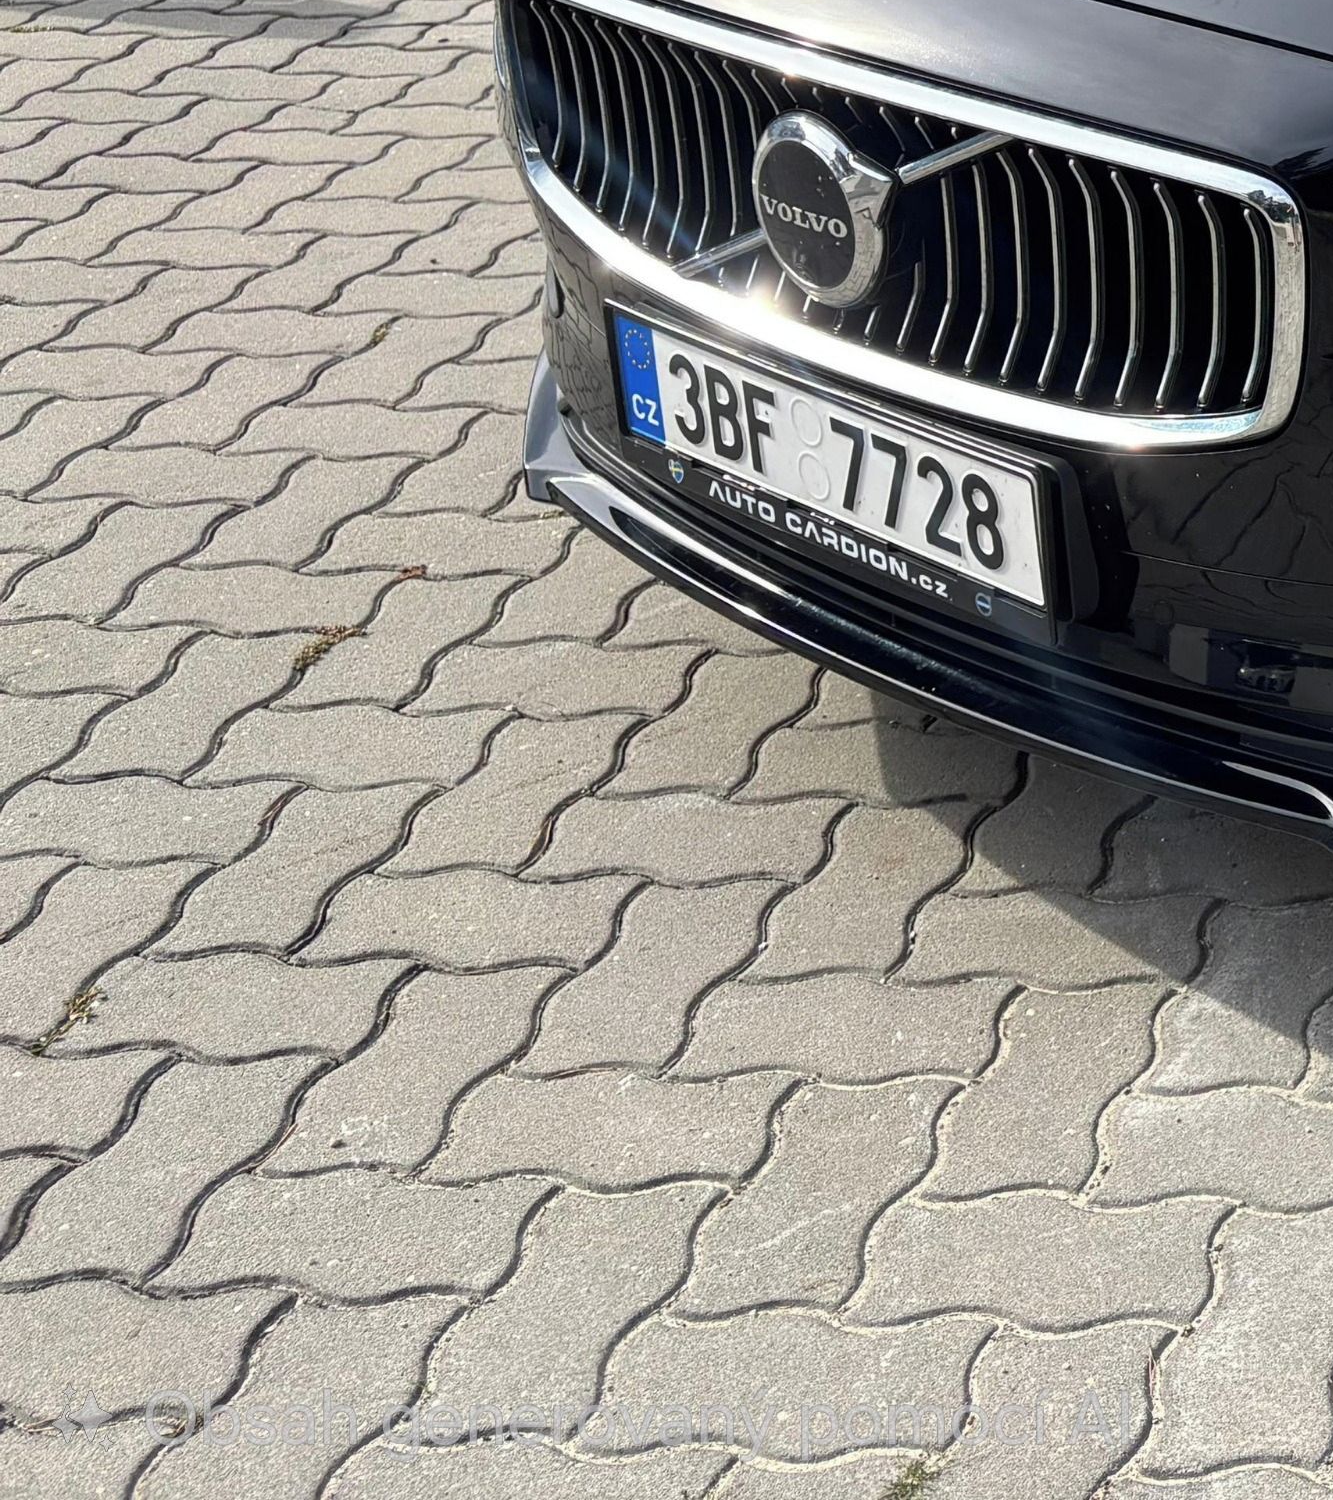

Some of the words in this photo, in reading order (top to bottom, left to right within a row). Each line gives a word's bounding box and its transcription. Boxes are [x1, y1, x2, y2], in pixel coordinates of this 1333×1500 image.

[759, 193, 848, 238] VOLVO
[631, 393, 660, 427] CZ
[669, 353, 775, 474] 3BF
[830, 416, 1004, 570] 7728
[709, 480, 775, 524] AUTO
